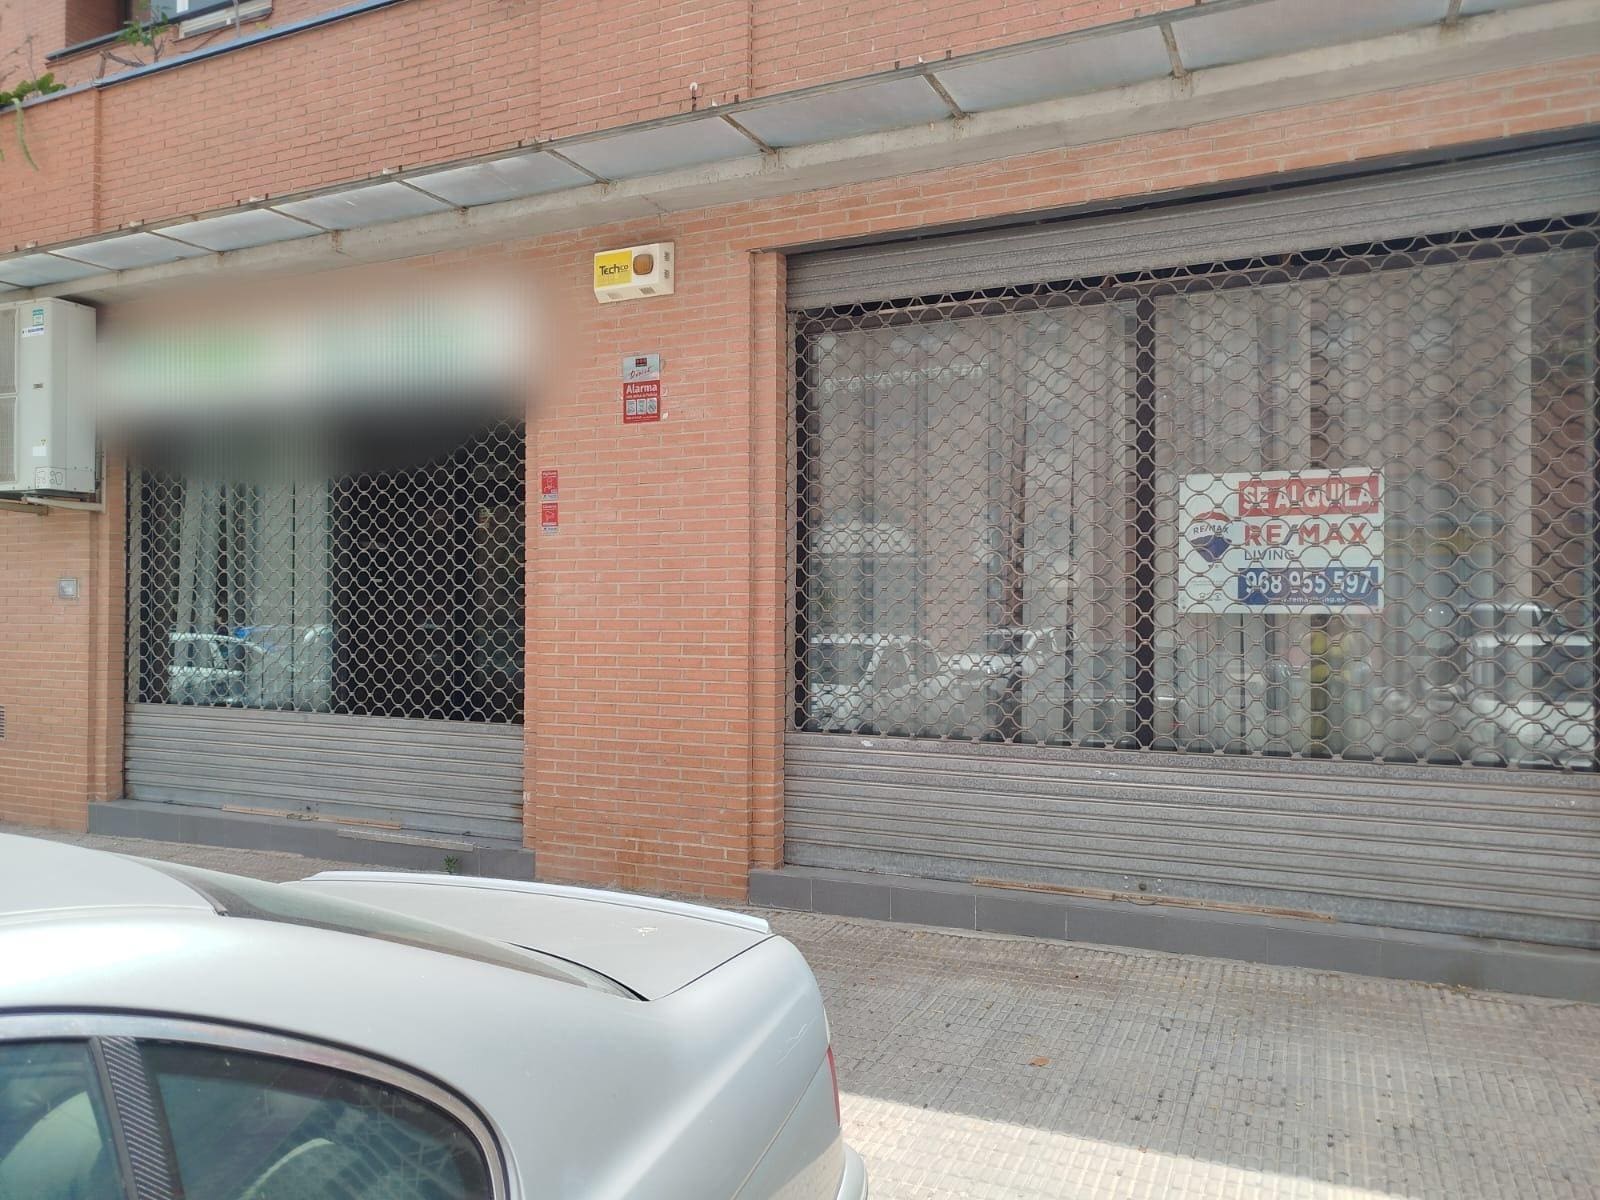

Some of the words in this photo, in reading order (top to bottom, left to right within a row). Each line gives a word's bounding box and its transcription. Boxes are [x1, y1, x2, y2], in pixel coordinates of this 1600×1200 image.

[626, 383, 658, 394] Alarma
[1243, 486, 1270, 509] SE
[1275, 481, 1374, 509] ALQUILA
[1244, 521, 1368, 546] RE/MAX
[1244, 549, 1296, 561] LIVING
[1246, 571, 1282, 593] 968
[1289, 571, 1326, 594] 955
[1334, 570, 1371, 594] 597
